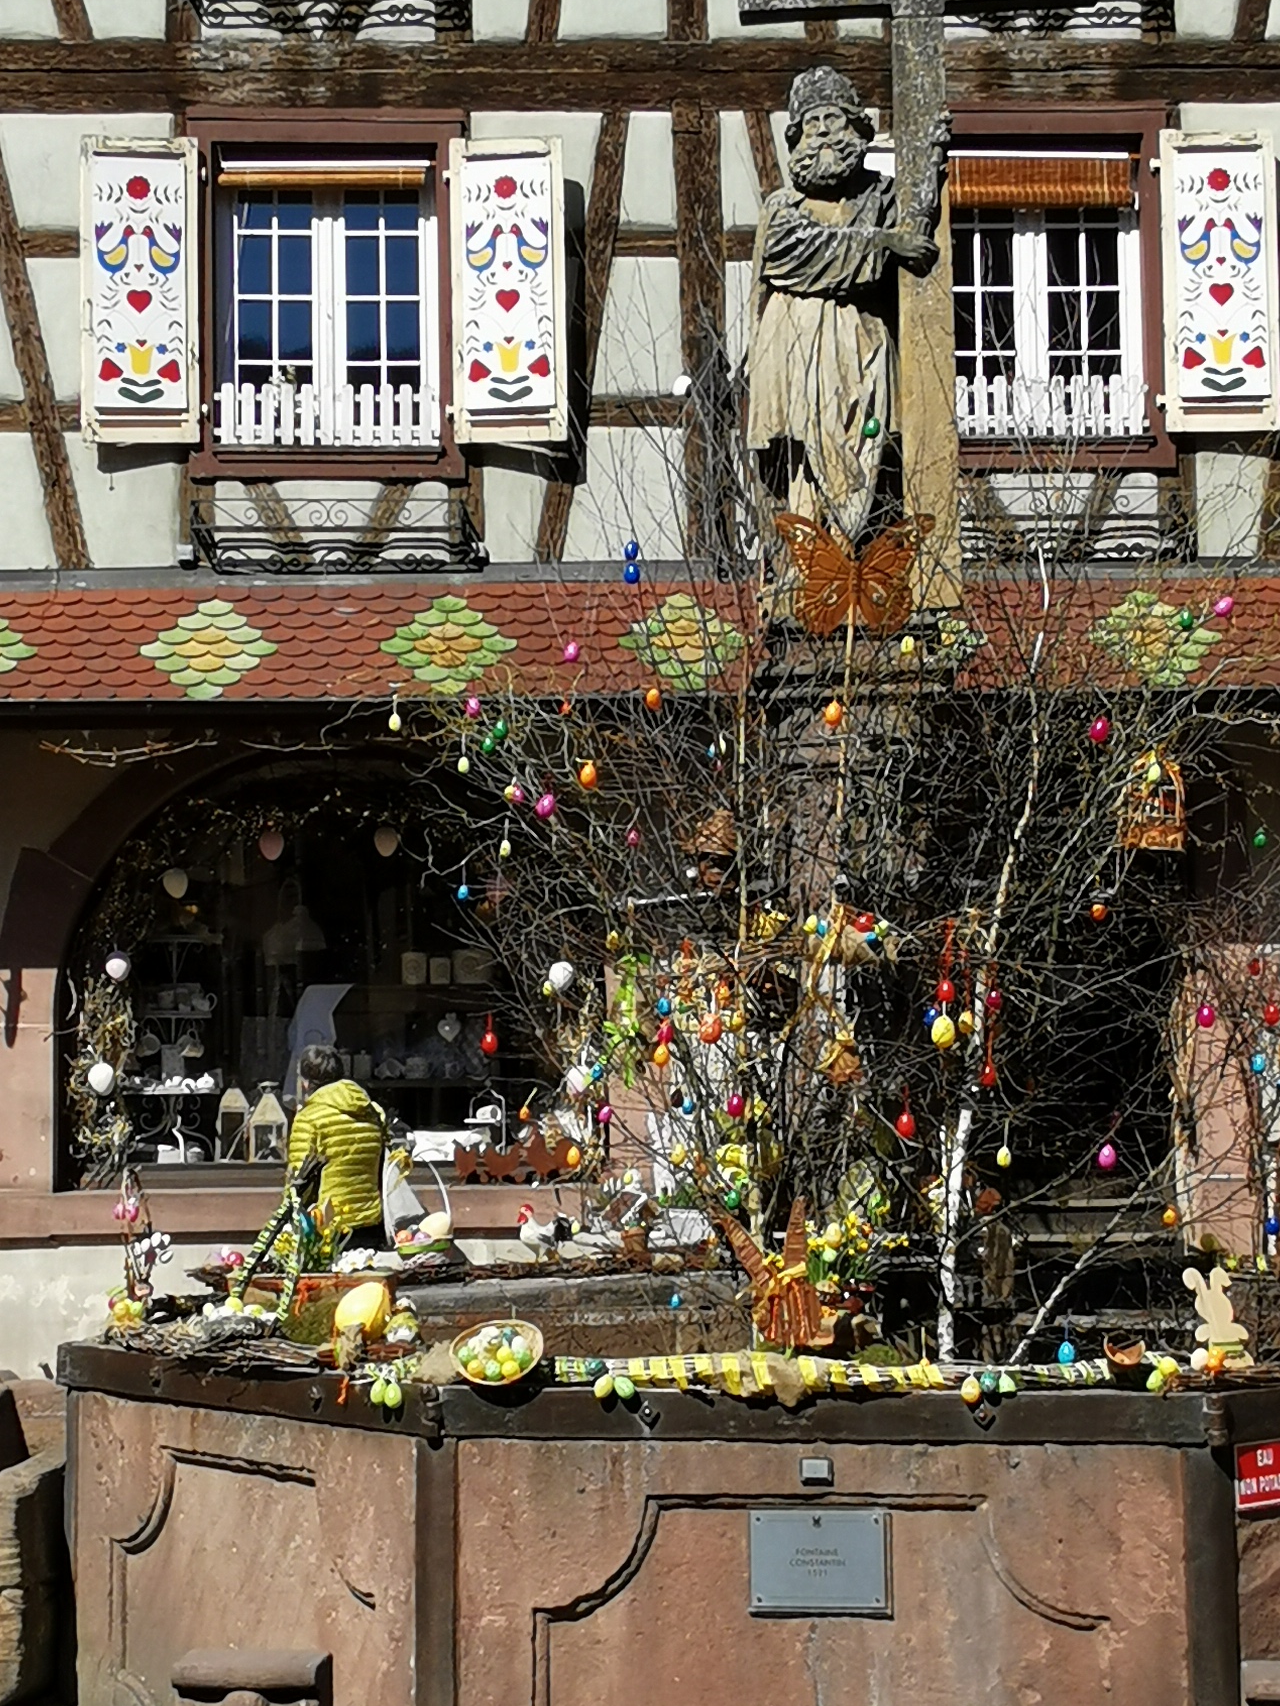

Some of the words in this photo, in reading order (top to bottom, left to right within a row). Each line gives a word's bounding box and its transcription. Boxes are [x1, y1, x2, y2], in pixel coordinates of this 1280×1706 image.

[1256, 1447, 1274, 1467] EAU
[1240, 1477, 1258, 1495] NON
[795, 1547, 839, 1557] FONTAINE
[788, 1557, 847, 1567] CONSTANTIN
